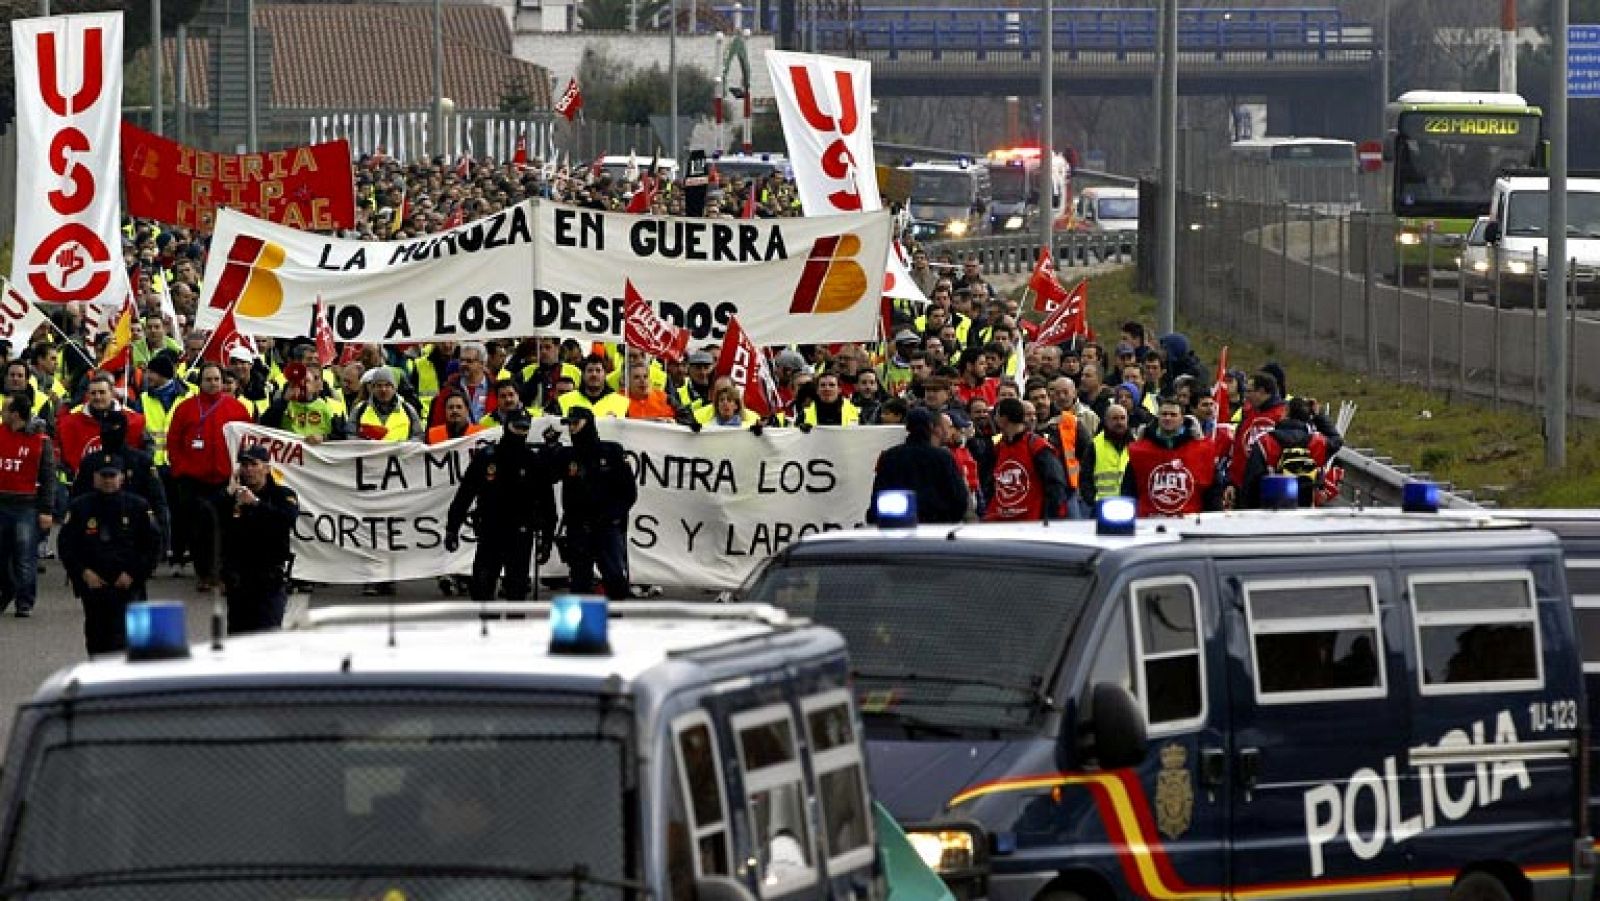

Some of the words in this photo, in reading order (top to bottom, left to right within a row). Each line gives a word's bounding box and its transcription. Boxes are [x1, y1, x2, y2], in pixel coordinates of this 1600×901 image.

[1451, 120, 1520, 134] MADRID
[176, 145, 318, 182] IBERIA
[318, 243, 366, 271] LA
[554, 209, 605, 251] EN
[630, 220, 788, 262] GUERRA
[309, 303, 365, 340] NO
[383, 302, 411, 338] A
[434, 292, 512, 334] LOS
[355, 456, 409, 490] LA
[757, 458, 836, 494] LOS
[293, 511, 443, 551] CORTES
[680, 518, 703, 552] Y
[1304, 709, 1532, 877] POLICIA
